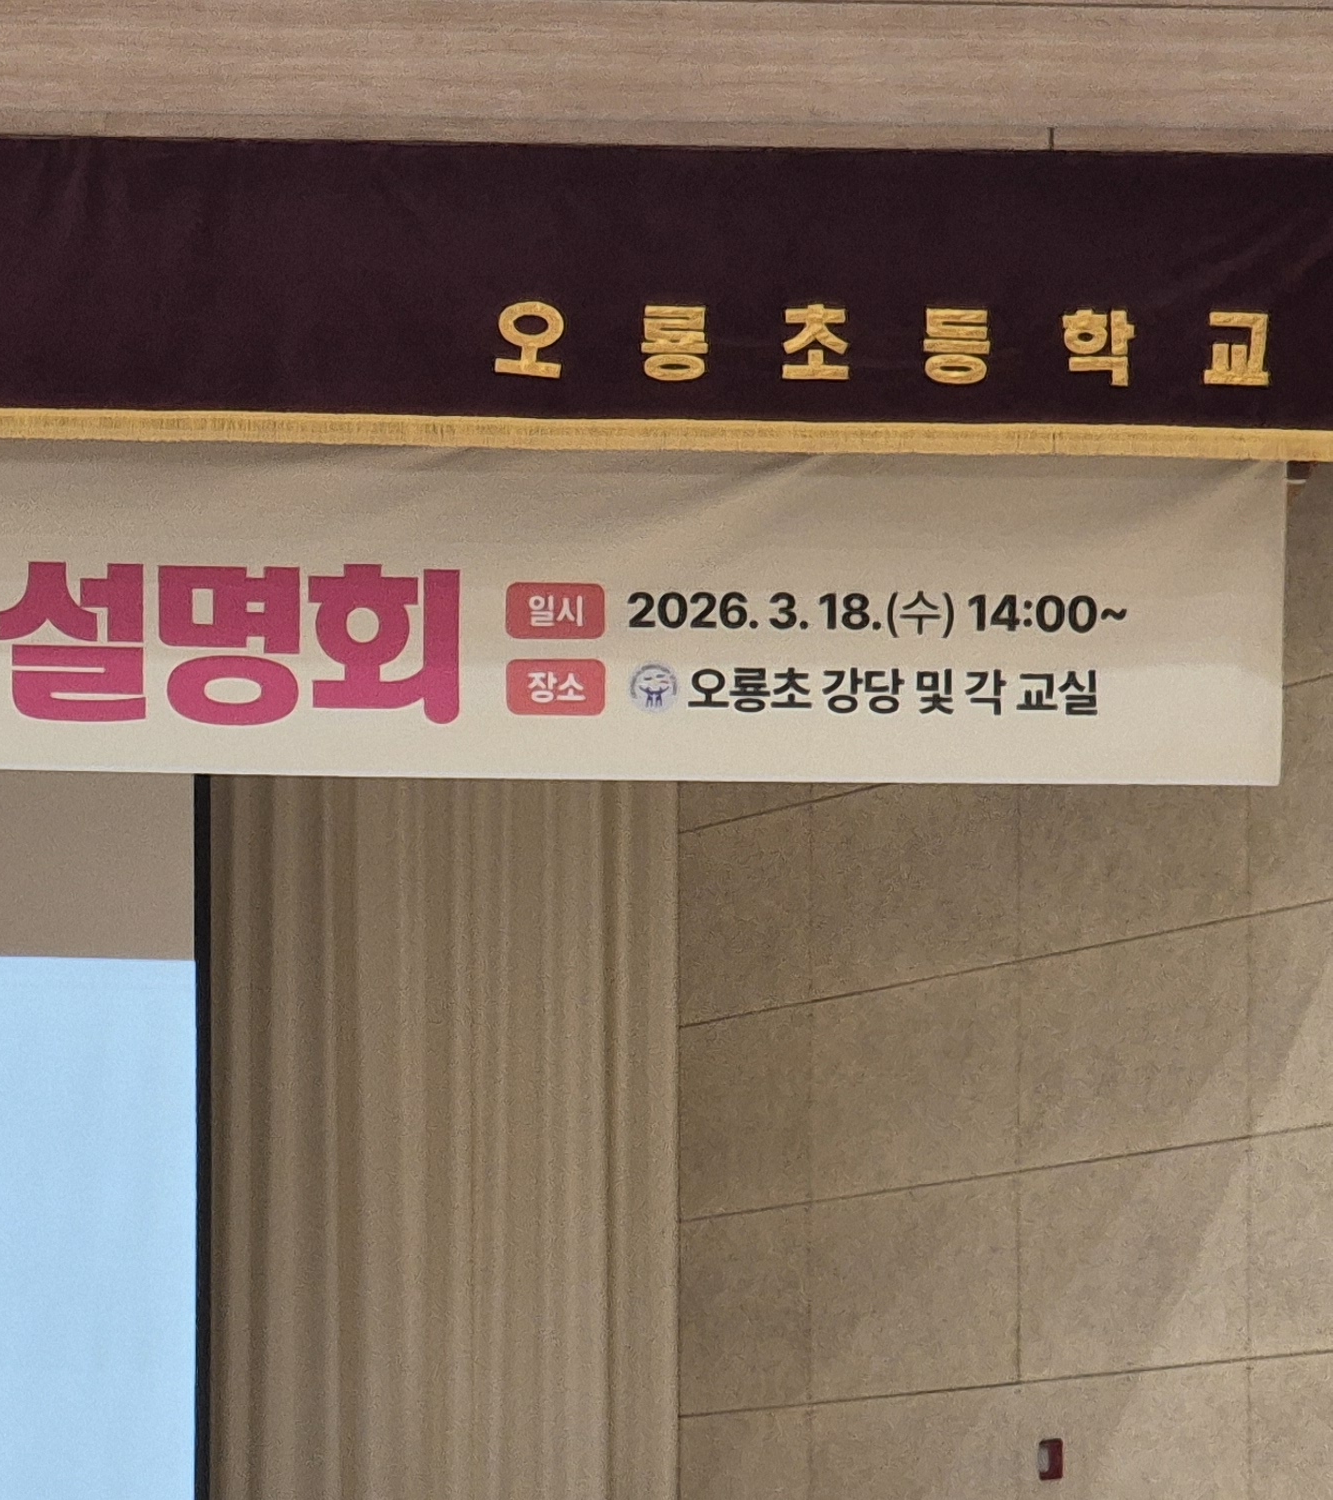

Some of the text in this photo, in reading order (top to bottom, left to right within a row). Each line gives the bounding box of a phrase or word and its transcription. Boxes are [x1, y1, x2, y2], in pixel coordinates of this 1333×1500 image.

[528, 594, 583, 627] 일시
[968, 594, 1128, 634] 14:00~
[528, 671, 586, 703] 장소
[687, 667, 812, 713] 오룡초
[822, 667, 905, 714] 강당
[916, 668, 954, 715] 및
[965, 668, 1007, 716] 각
[1016, 669, 1098, 716] 교실
